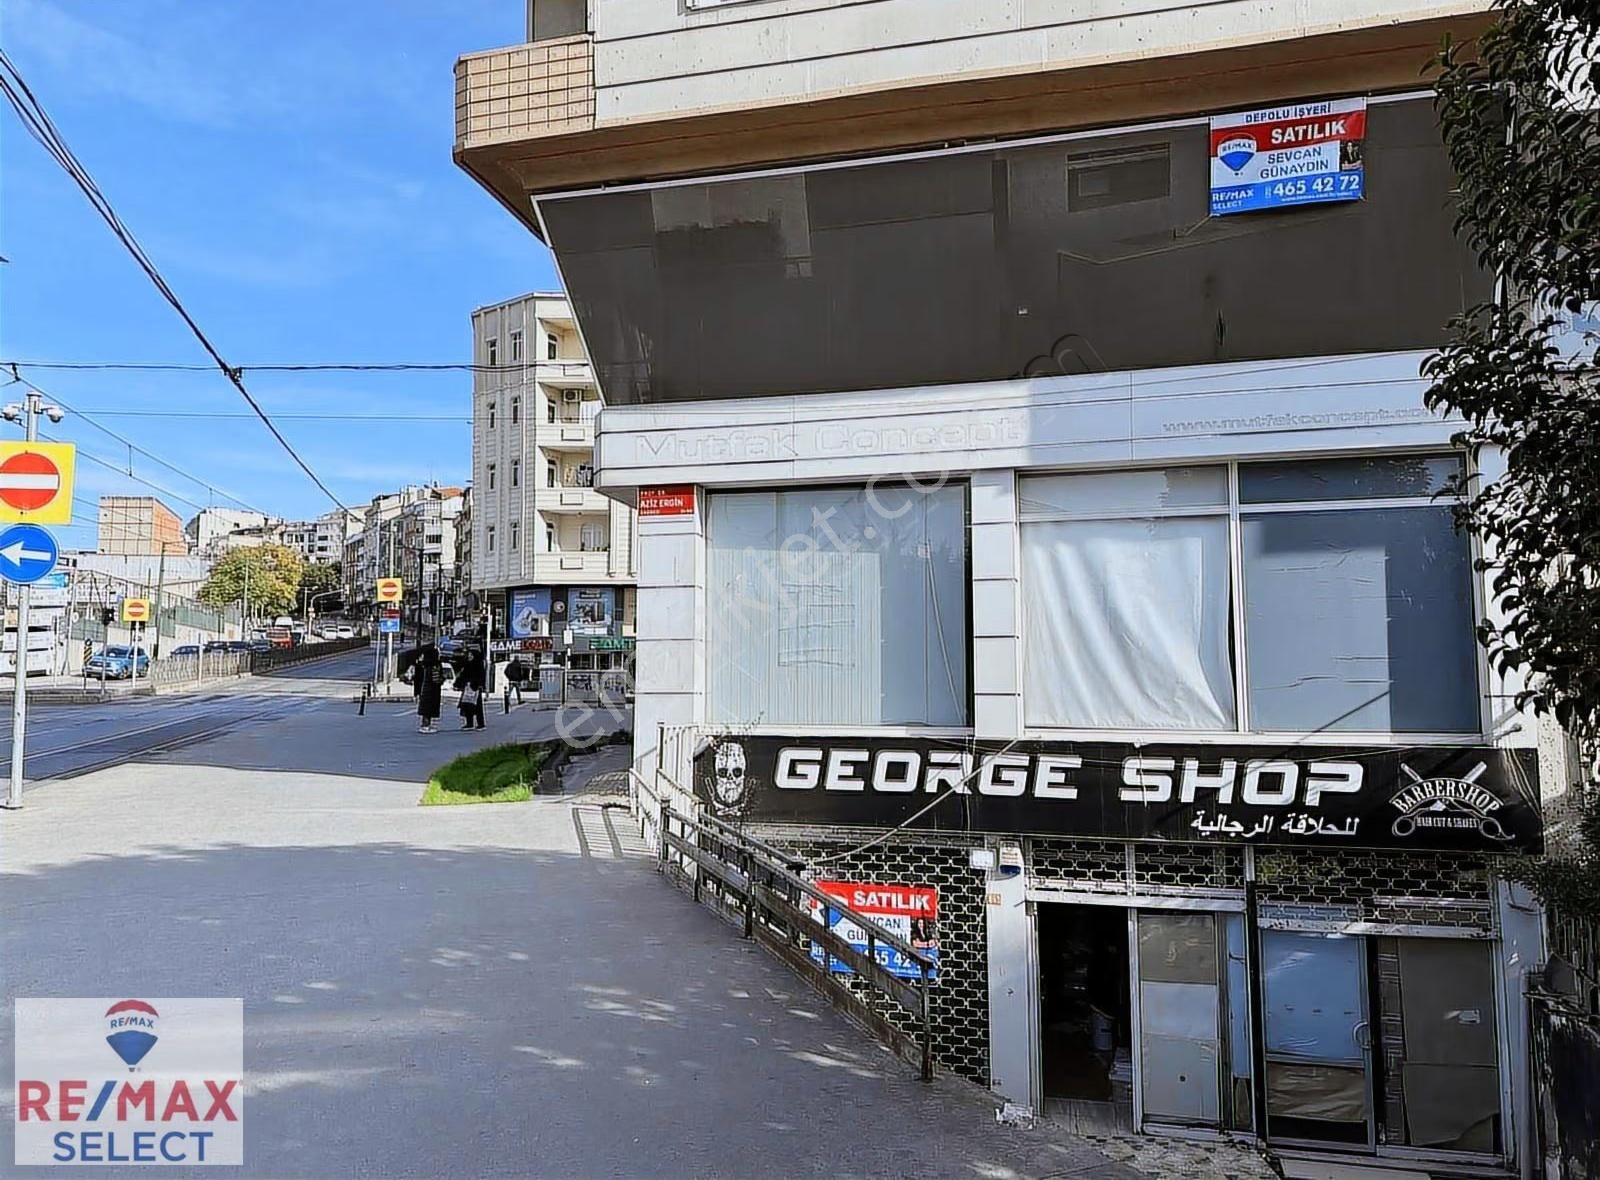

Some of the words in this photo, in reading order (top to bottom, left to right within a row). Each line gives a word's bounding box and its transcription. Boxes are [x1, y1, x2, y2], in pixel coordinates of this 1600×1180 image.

[1245, 109, 1290, 124] DEPOLU
[1271, 119, 1346, 145] SATILIK
[1267, 146, 1321, 165] SEVCAN
[1260, 159, 1329, 180] GÜNAYDIN
[1212, 188, 1254, 203] RE/MAX
[1273, 180, 1306, 197] 465
[1312, 176, 1334, 193] 42
[1339, 174, 1360, 191] 72
[635, 428, 799, 460] Mutfak
[814, 416, 1025, 455] Concept
[774, 746, 1082, 800] GEORGE
[1118, 756, 1364, 807] SHOP
[1392, 779, 1500, 816] BARBERSHOP
[1190, 809, 1275, 838] الرجالية
[1280, 812, 1361, 836] للحلاقة
[853, 890, 931, 911] SATILIK
